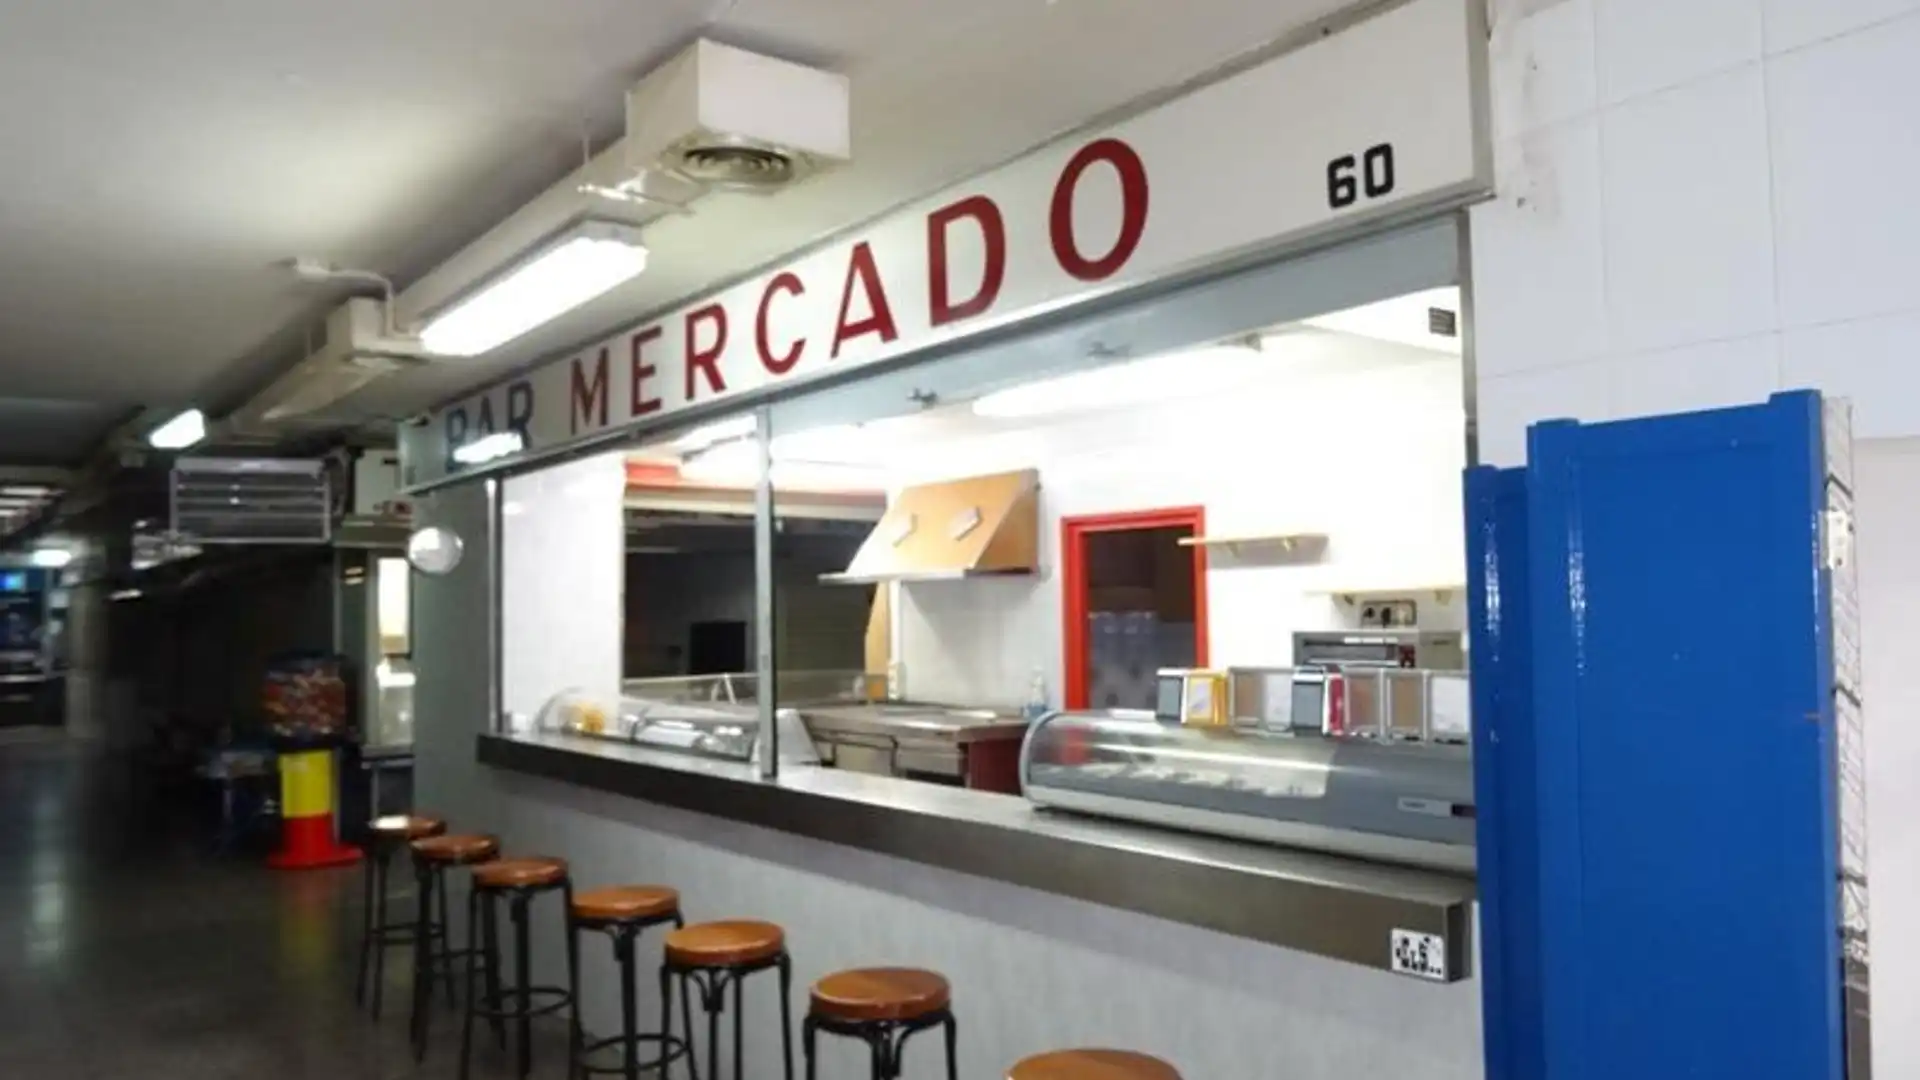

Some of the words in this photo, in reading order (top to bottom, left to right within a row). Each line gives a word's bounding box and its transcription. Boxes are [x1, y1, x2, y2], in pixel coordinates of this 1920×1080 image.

[1327, 143, 1395, 209] 60
[445, 382, 534, 475] BAR
[570, 138, 1150, 437] MERCADO
